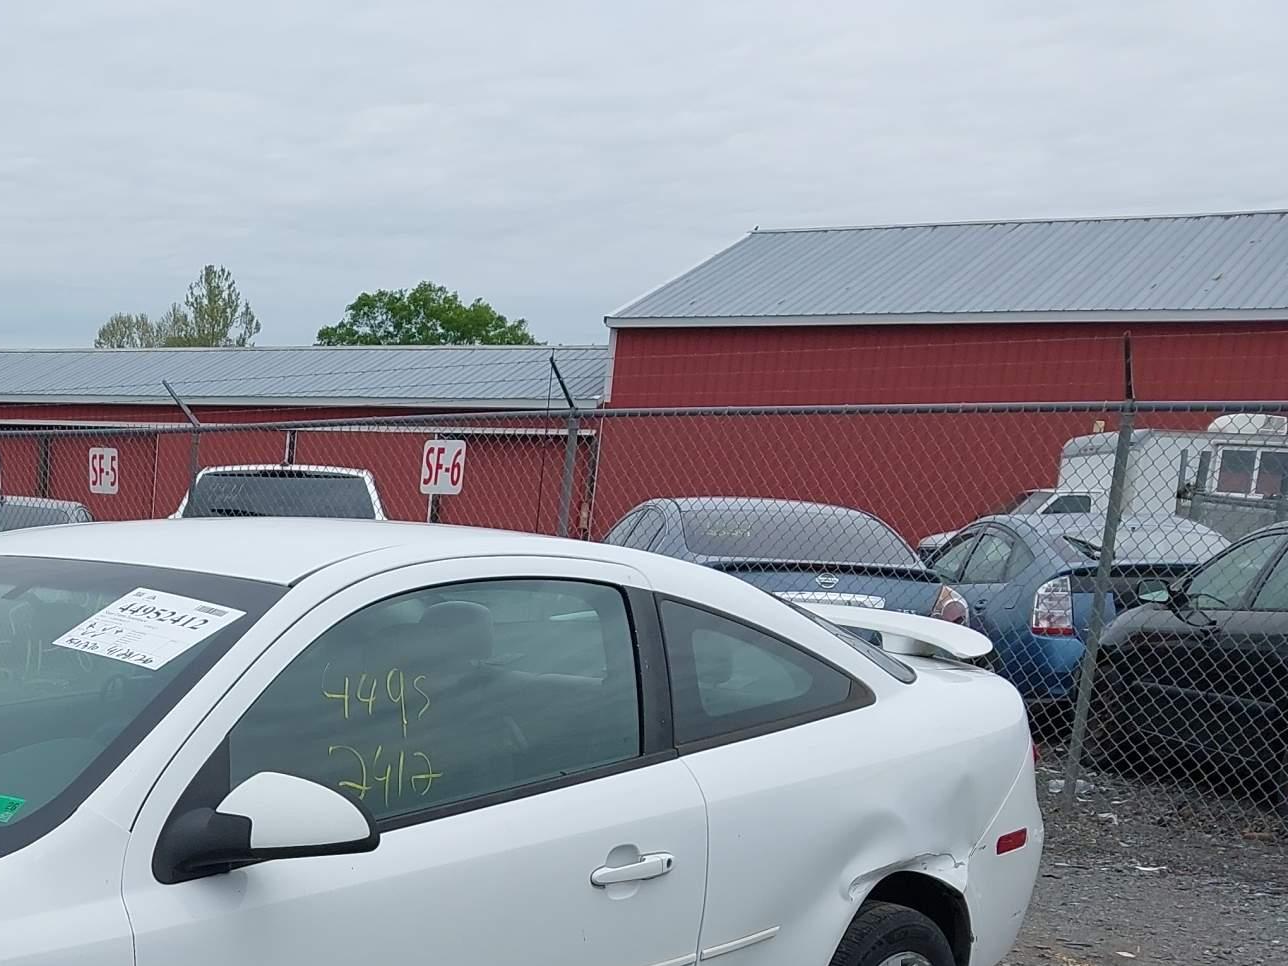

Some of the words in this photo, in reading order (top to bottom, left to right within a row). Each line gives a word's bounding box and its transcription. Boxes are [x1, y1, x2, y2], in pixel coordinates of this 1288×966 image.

[91, 454, 116, 487] SF-5
[423, 447, 461, 487] SF-6
[118, 602, 209, 631] 44952412
[328, 745, 443, 808] 2412
